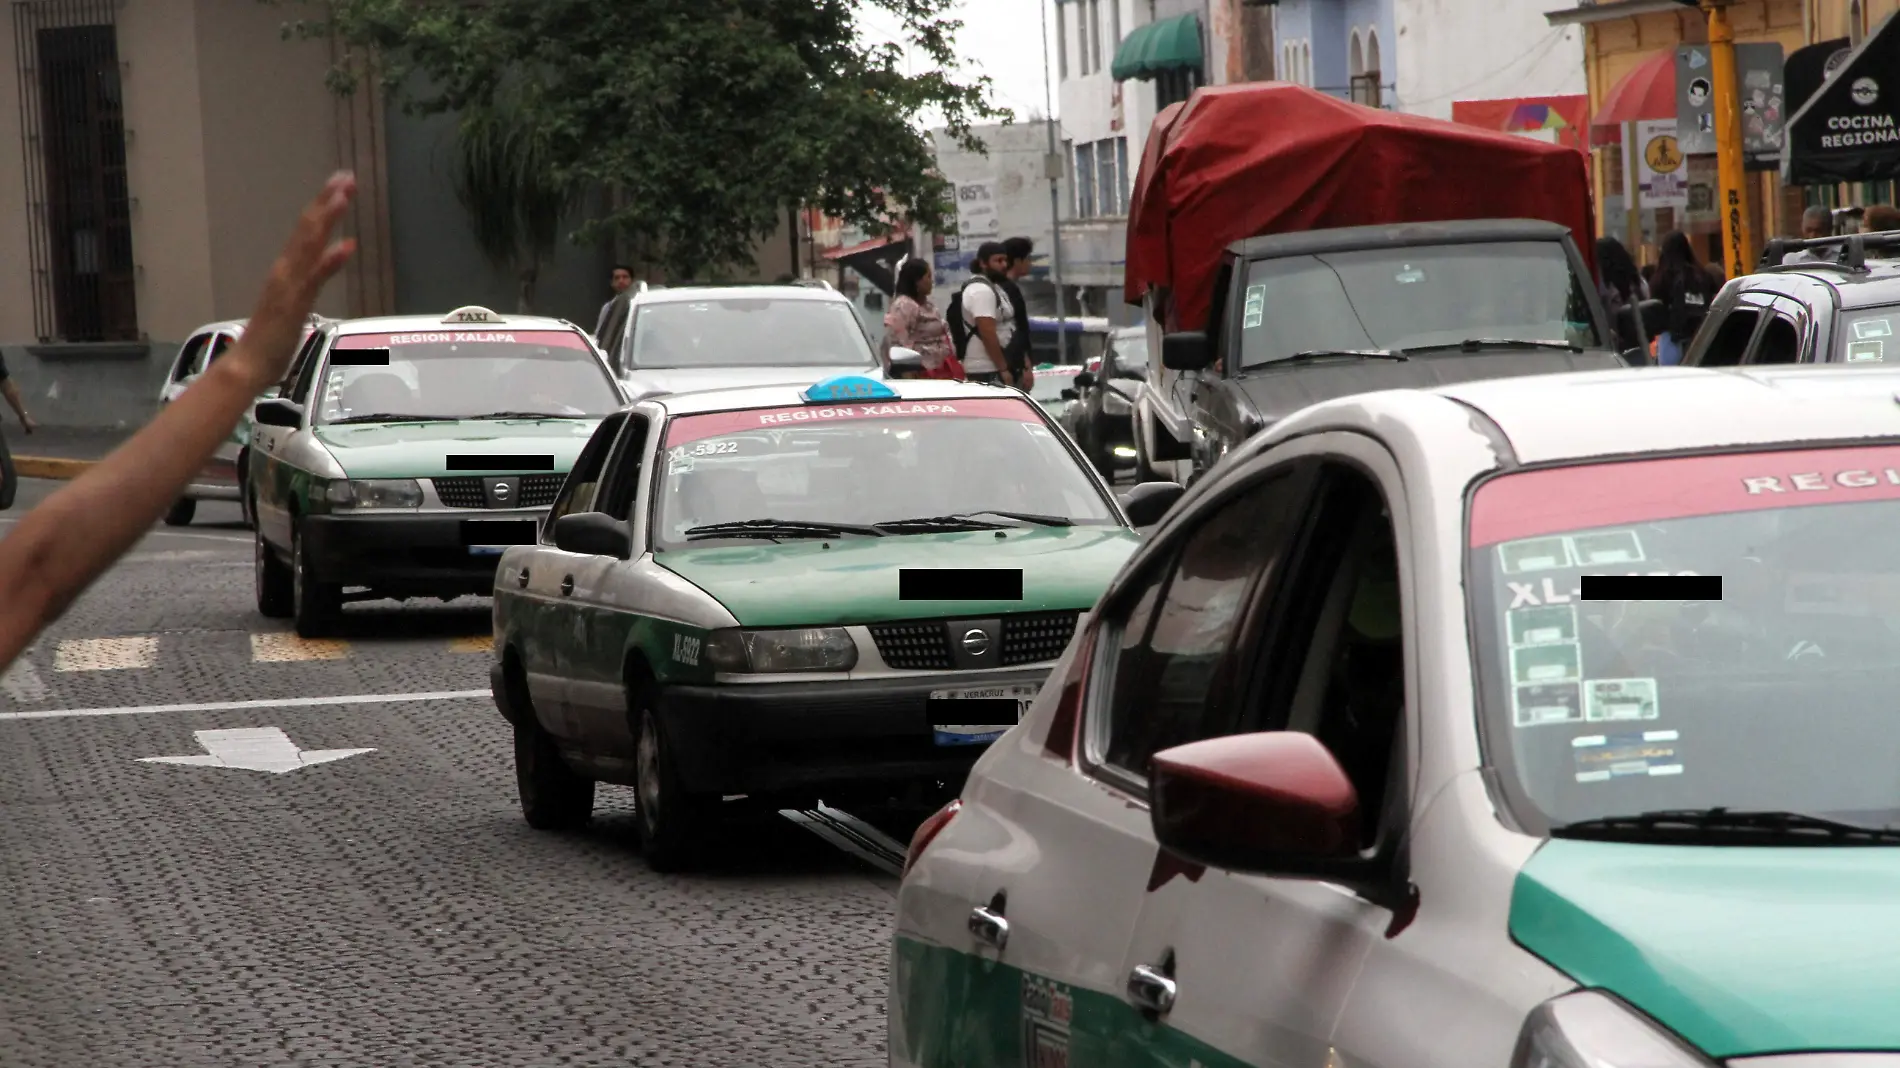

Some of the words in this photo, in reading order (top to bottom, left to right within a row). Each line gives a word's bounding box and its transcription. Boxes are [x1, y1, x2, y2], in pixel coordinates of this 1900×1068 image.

[1828, 114, 1894, 130] COCINA
[1821, 127, 1900, 148] REGIONA
[960, 184, 991, 201] 85%
[457, 313, 487, 321] TAXI
[390, 333, 450, 344] REGION
[455, 332, 516, 342] XALAPA
[829, 383, 873, 399] TAXI
[861, 404, 957, 416] XALAPA
[668, 441, 739, 463] XL-5922
[672, 633, 700, 666] XL-5922
[963, 689, 1005, 699] VERACRUZ
